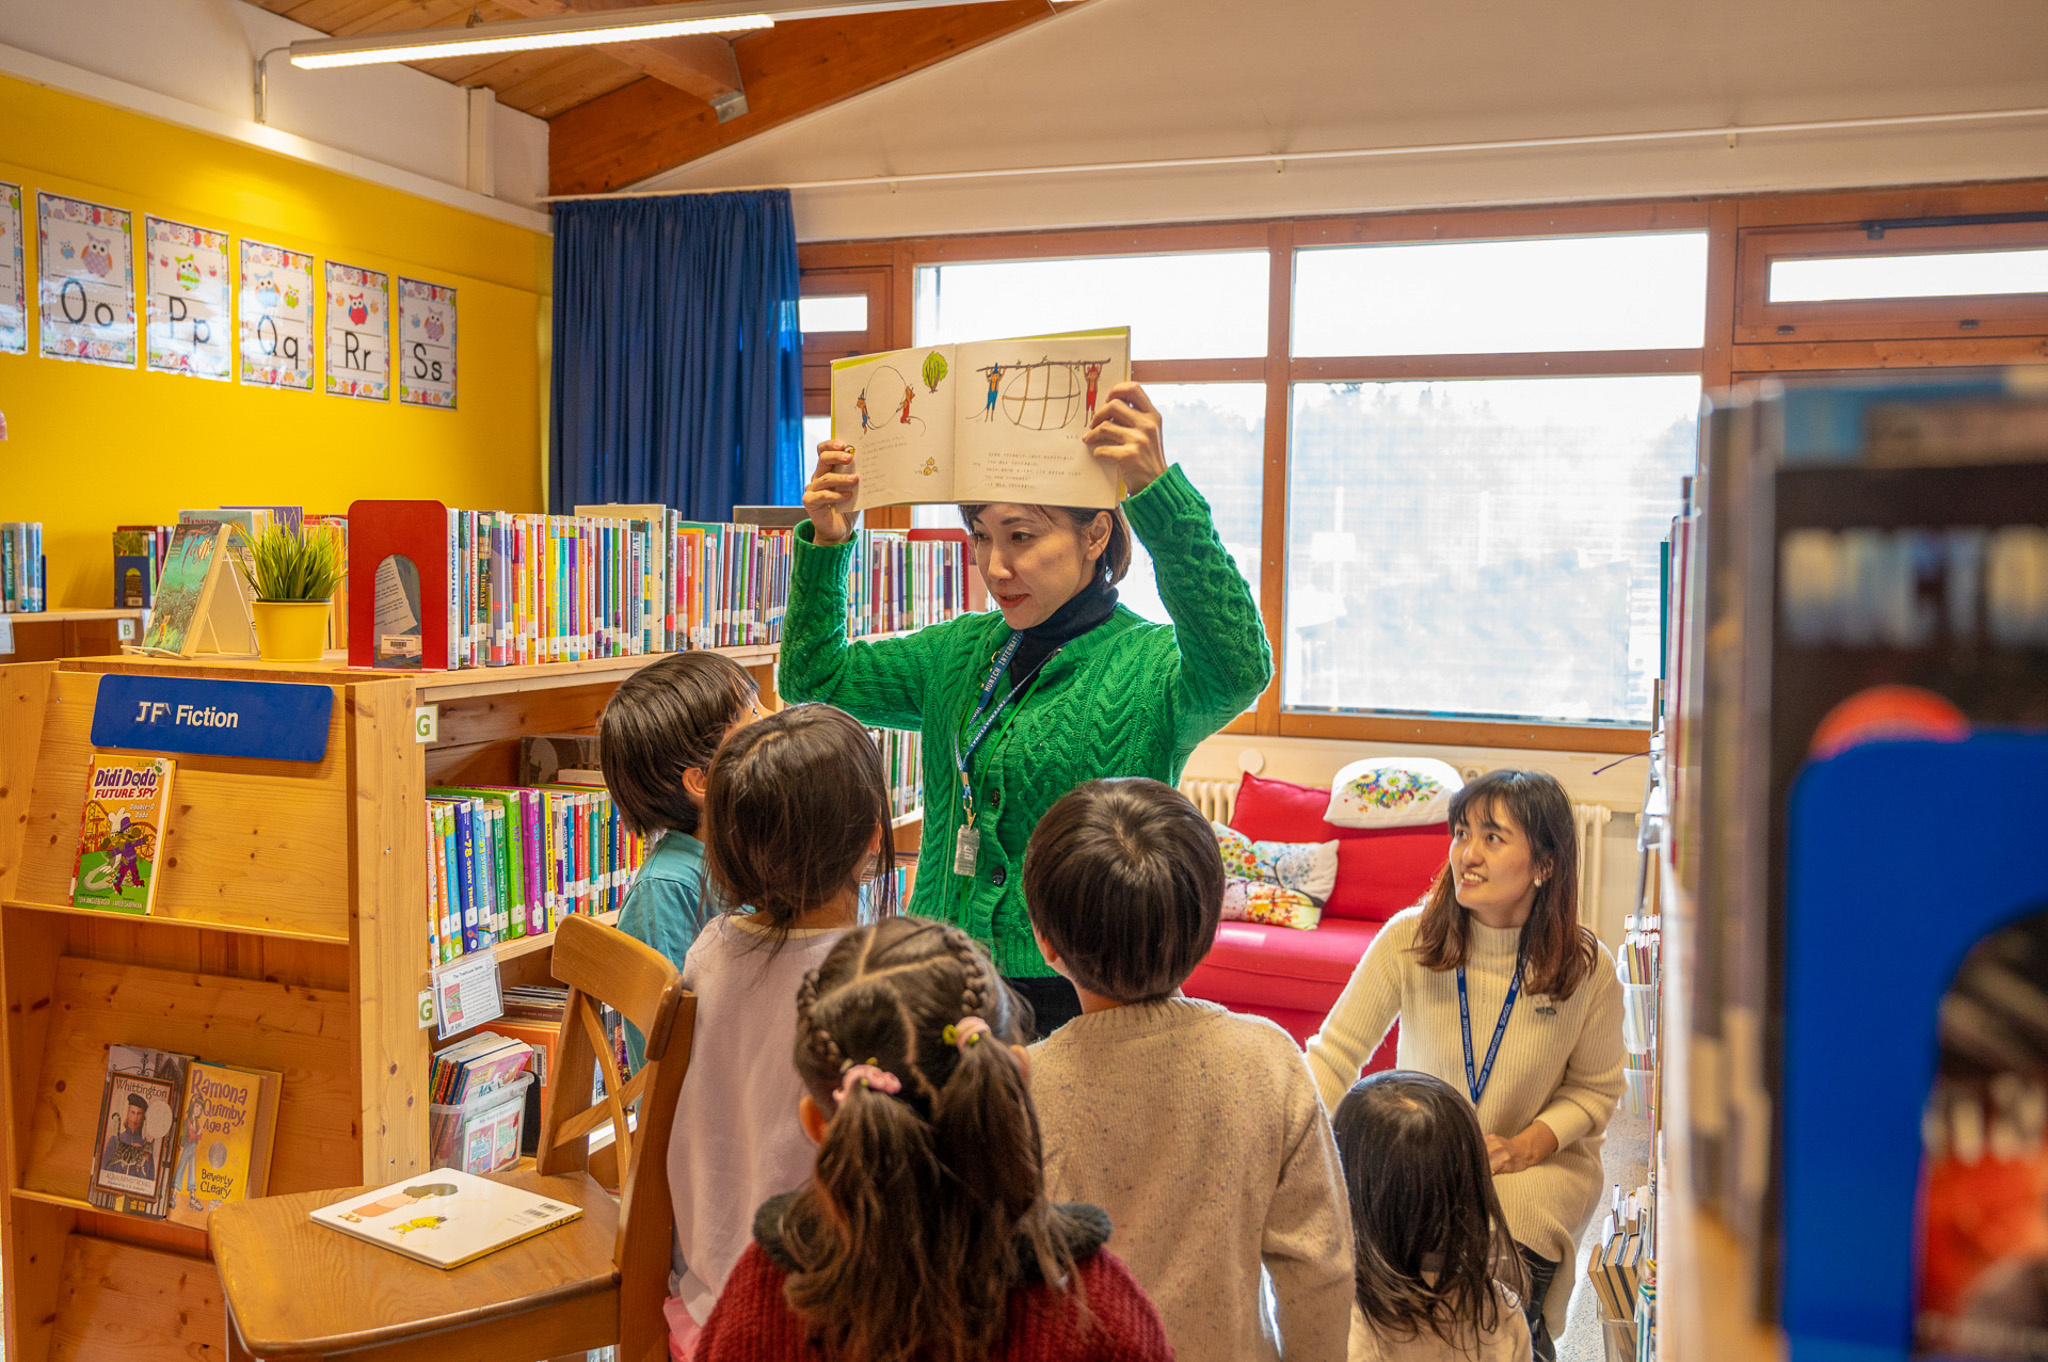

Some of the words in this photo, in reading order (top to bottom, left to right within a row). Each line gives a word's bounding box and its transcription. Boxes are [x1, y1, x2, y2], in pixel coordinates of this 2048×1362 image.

[61, 278, 115, 327] Oo
[168, 296, 212, 352] Pp
[257, 314, 300, 370] Qq
[345, 330, 372, 371] Rr
[412, 343, 443, 382] Ss
[480, 573, 488, 610] LIBRARY
[123, 624, 132, 636] B
[984, 667, 1002, 692] MUNICH
[998, 630, 1024, 666] INTERNATI
[176, 704, 239, 728] Fiction
[416, 714, 431, 736] G
[94, 769, 123, 787] Didi
[122, 768, 157, 789] Dodo
[94, 788, 136, 798] FUTURE
[136, 787, 158, 798] SPY
[464, 839, 475, 884] 78-STORY
[419, 999, 433, 1021] G
[115, 1079, 168, 1099] Whittington
[190, 1069, 248, 1106] Ramona
[203, 1098, 246, 1127] Quimby,
[203, 1119, 221, 1133] Age
[222, 1121, 231, 1135] 8
